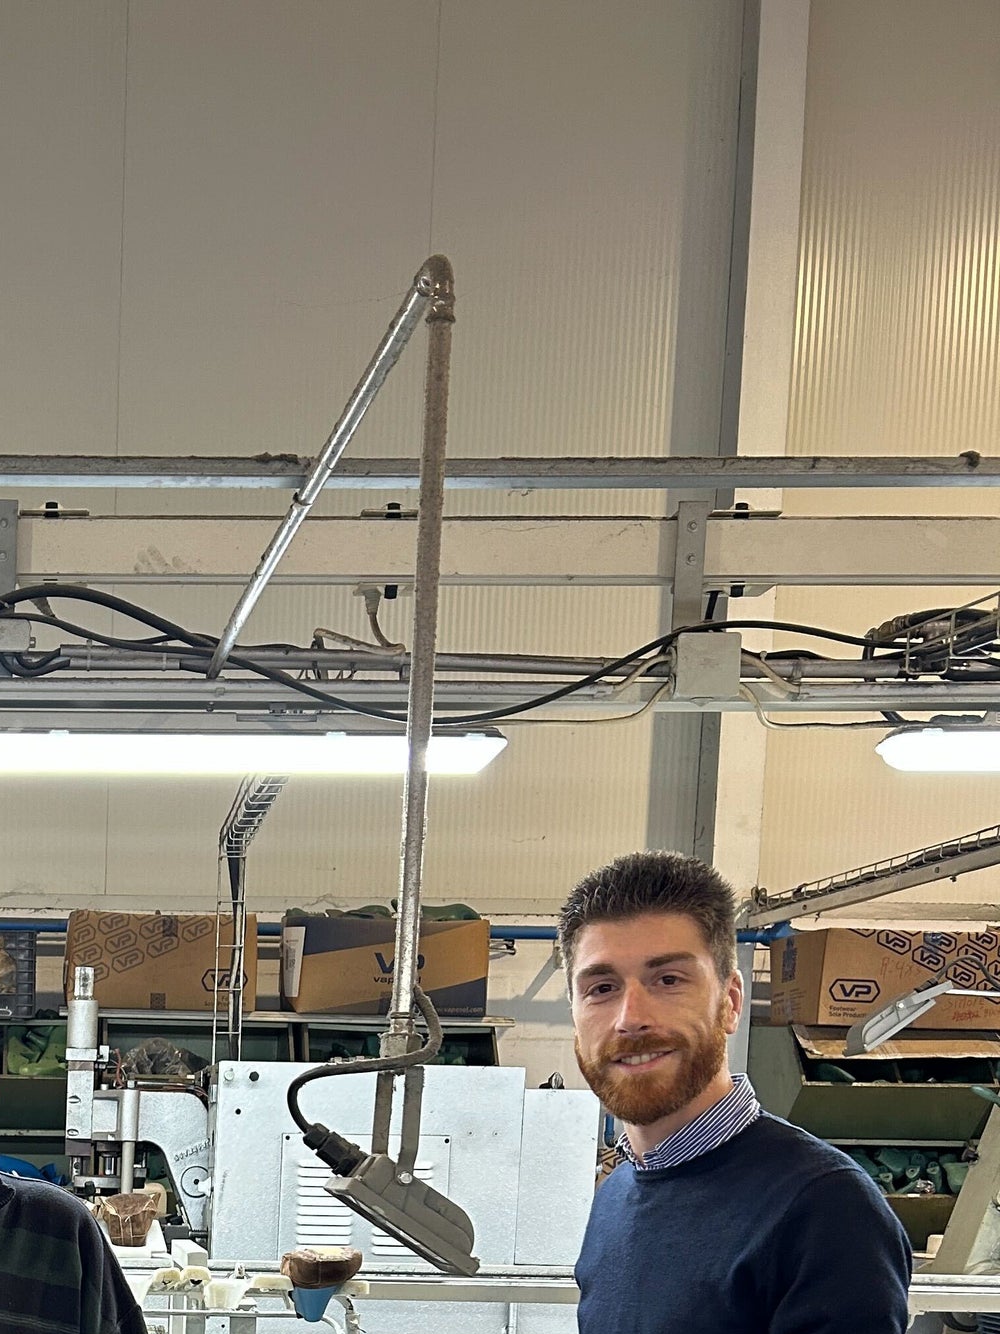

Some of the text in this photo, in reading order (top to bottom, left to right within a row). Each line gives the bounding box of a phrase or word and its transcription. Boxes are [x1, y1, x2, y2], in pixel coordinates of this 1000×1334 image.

[187, 921, 209, 937] VP
[109, 933, 132, 948] VP
[151, 939, 175, 953] VP
[884, 932, 906, 949] VP
[116, 952, 139, 967] VP
[920, 949, 941, 966] VP
[373, 976, 422, 984] vapl
[952, 966, 972, 982] VP
[839, 983, 872, 998] VP
